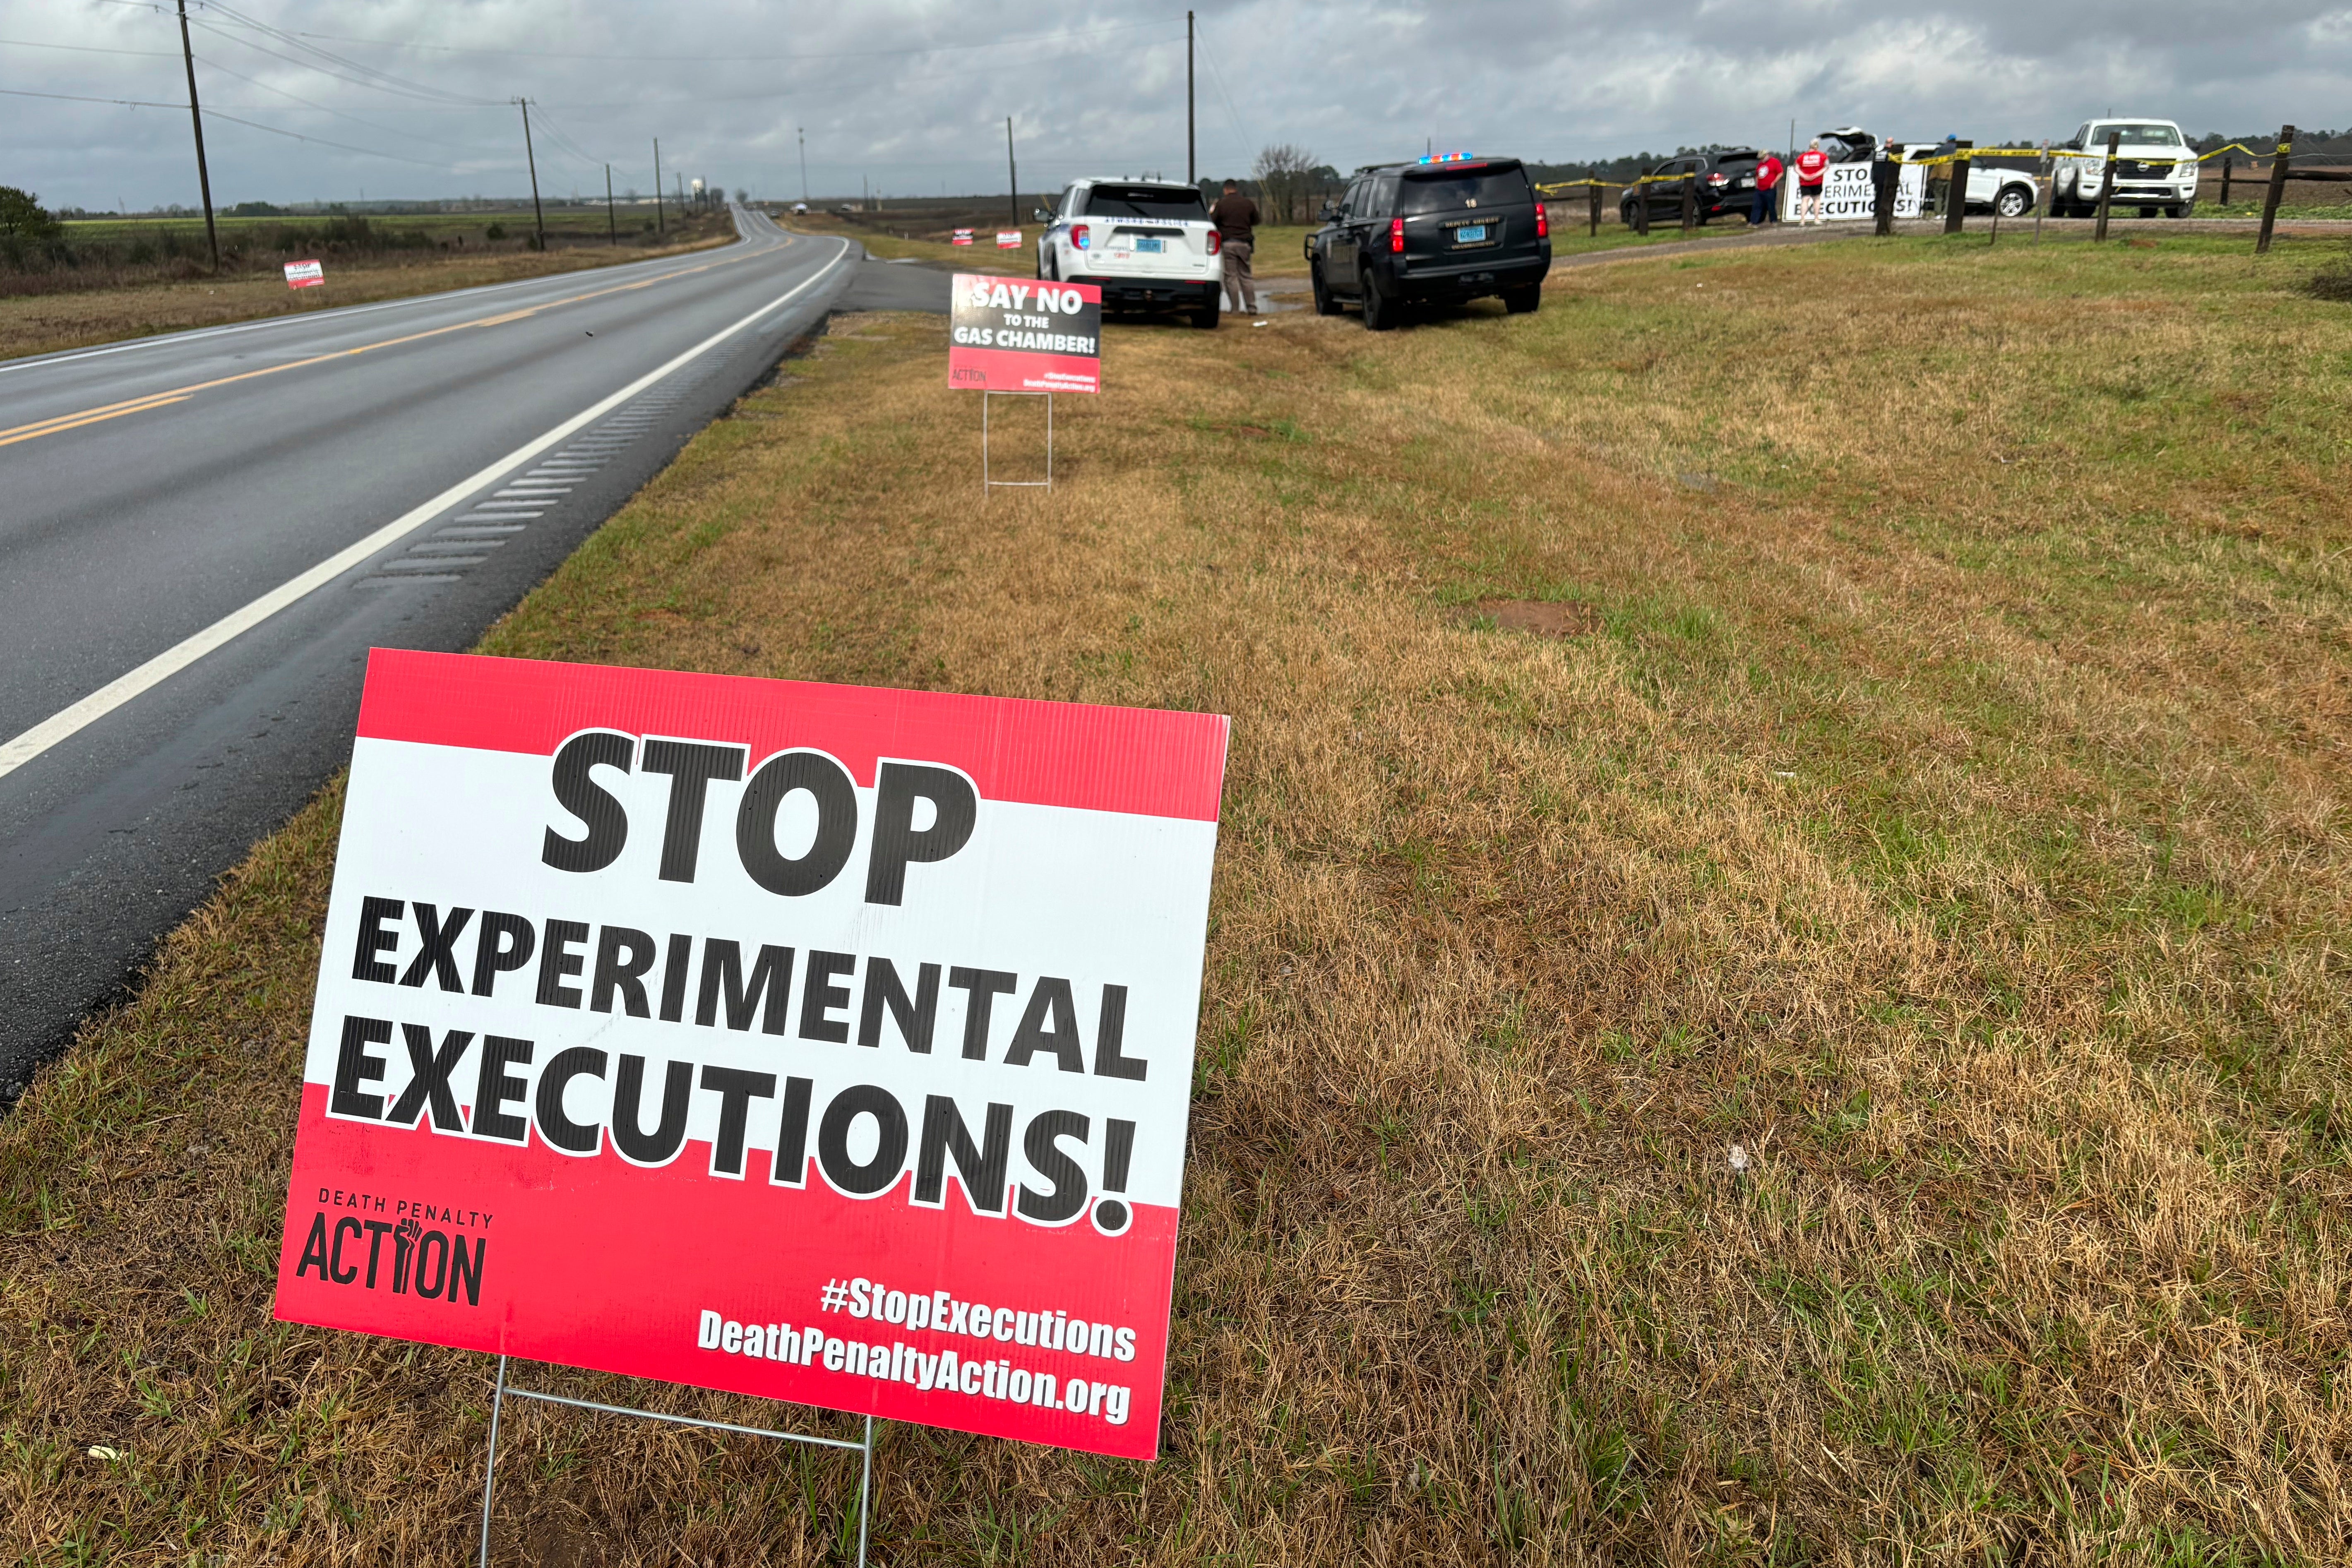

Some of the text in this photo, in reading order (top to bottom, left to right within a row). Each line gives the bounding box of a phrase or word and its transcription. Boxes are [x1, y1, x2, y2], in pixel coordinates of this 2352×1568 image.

[1833, 168, 1868, 182] STO
[954, 327, 1096, 354] GAS CHAMBER!
[971, 282, 1083, 315] SAY NO
[1004, 314, 1049, 329] TO THE
[541, 732, 977, 906] STOP
[352, 896, 1148, 1081] EXPERIMENTAL
[329, 1015, 1136, 1235] EXECUTIONS!
[319, 1188, 493, 1229] DEATH PENALTY
[296, 1212, 486, 1306] ACTION
[820, 1277, 1136, 1362] #StopExecutions
[698, 1309, 1131, 1425] DeathPenaltyAction.org
